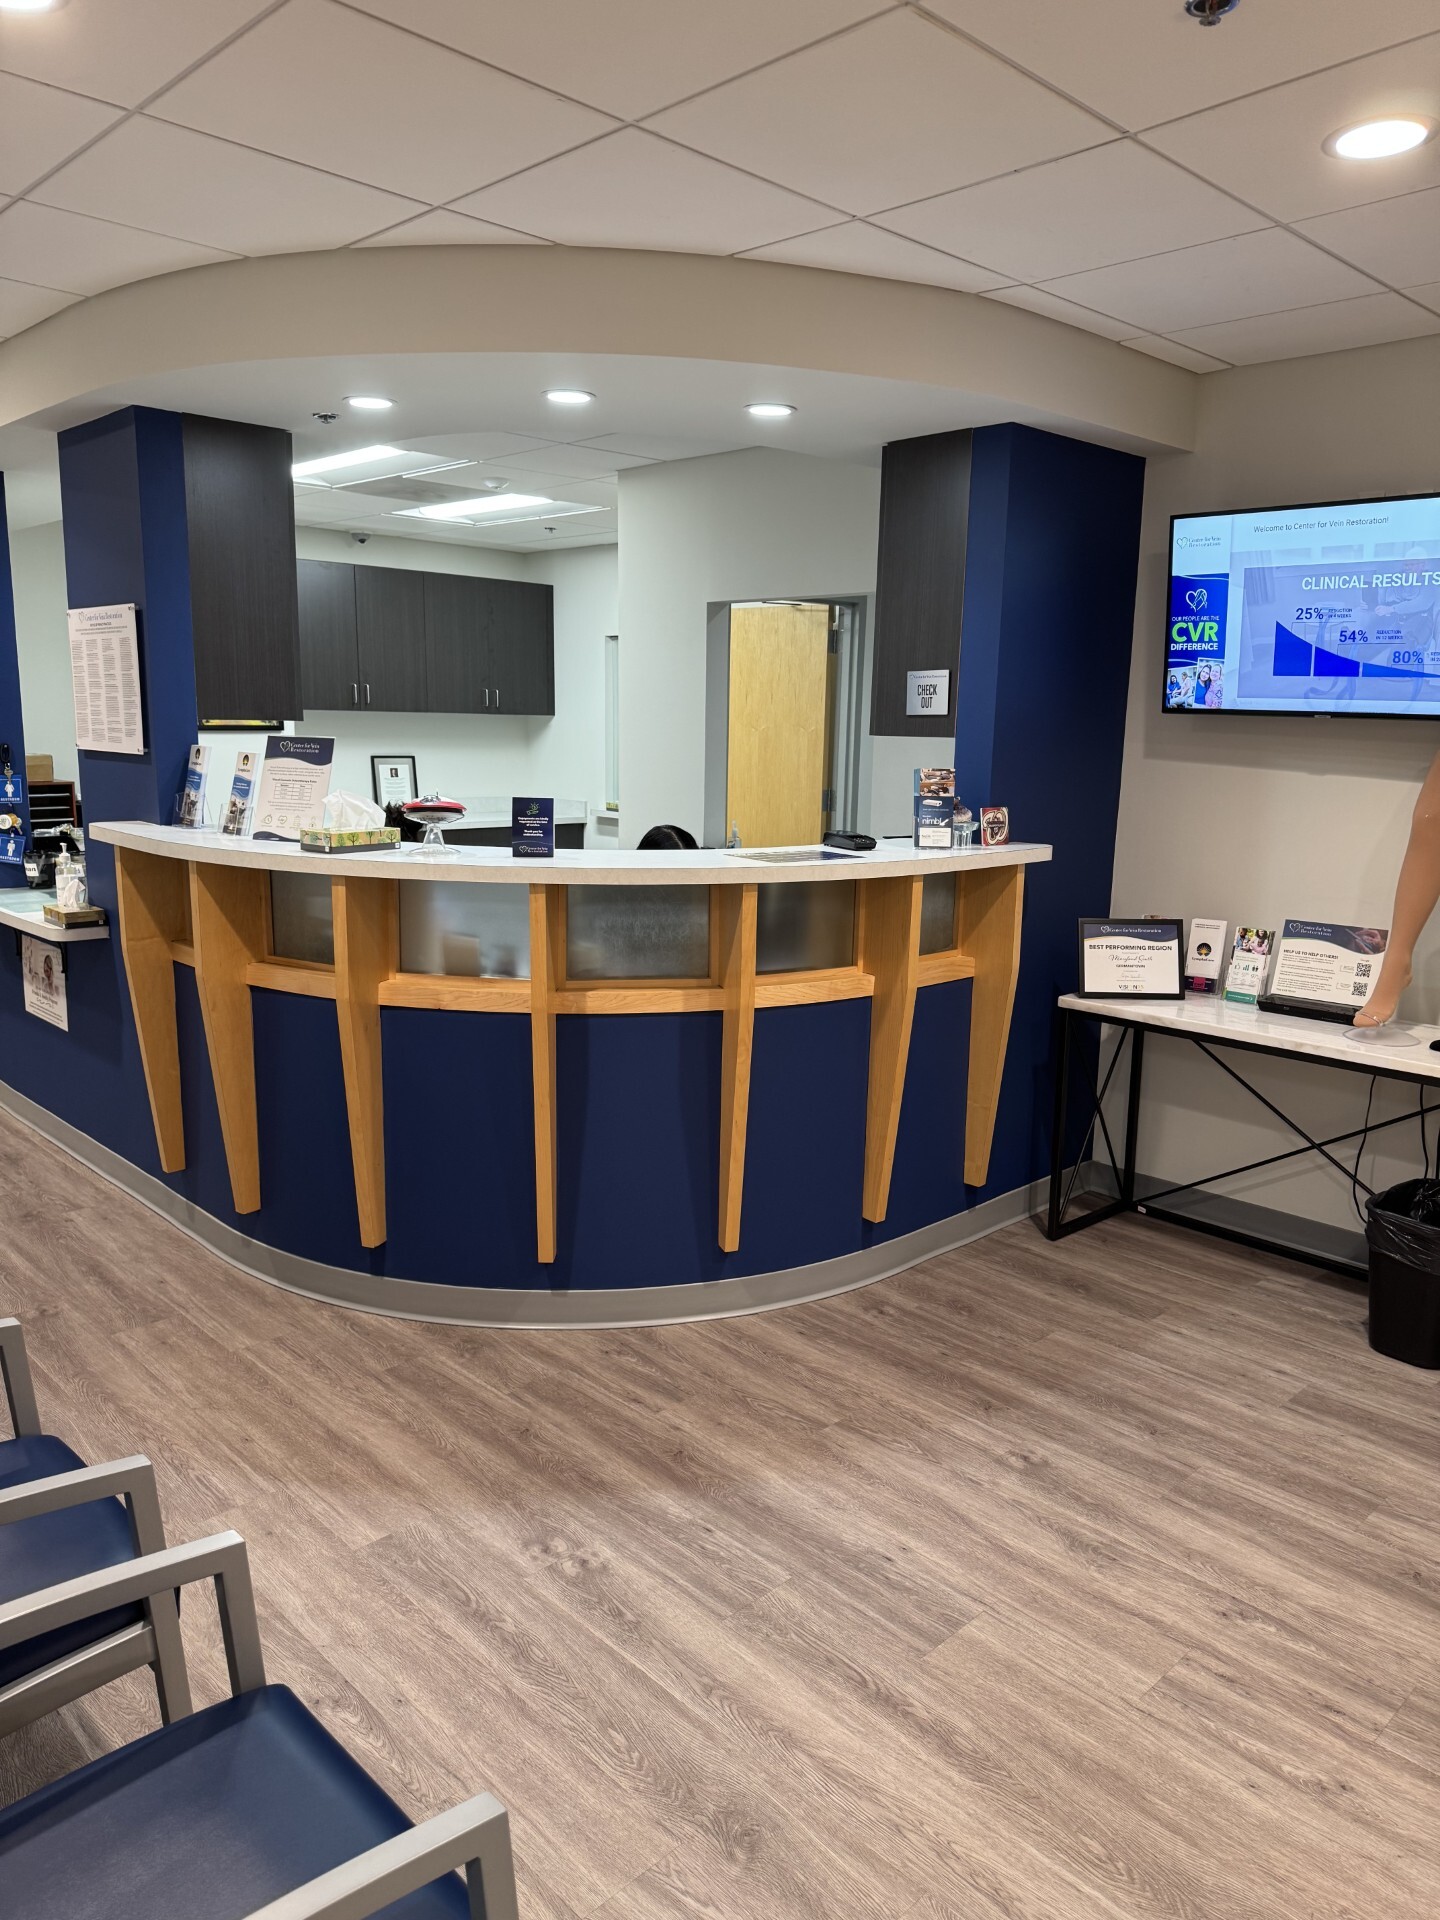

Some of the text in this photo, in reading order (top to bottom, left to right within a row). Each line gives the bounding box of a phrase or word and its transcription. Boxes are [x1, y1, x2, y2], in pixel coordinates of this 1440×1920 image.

[1254, 525, 1284, 533] Welcome
[1346, 516, 1389, 526] Restoration!
[1302, 572, 1440, 590] CLINICAL RESULTS
[1295, 607, 1324, 620] 25%
[1172, 622, 1218, 642] CVR
[1338, 630, 1368, 642] 54%
[1392, 650, 1424, 664] 80%
[918, 684, 938, 696] CHECK
[921, 696, 933, 708] OUT
